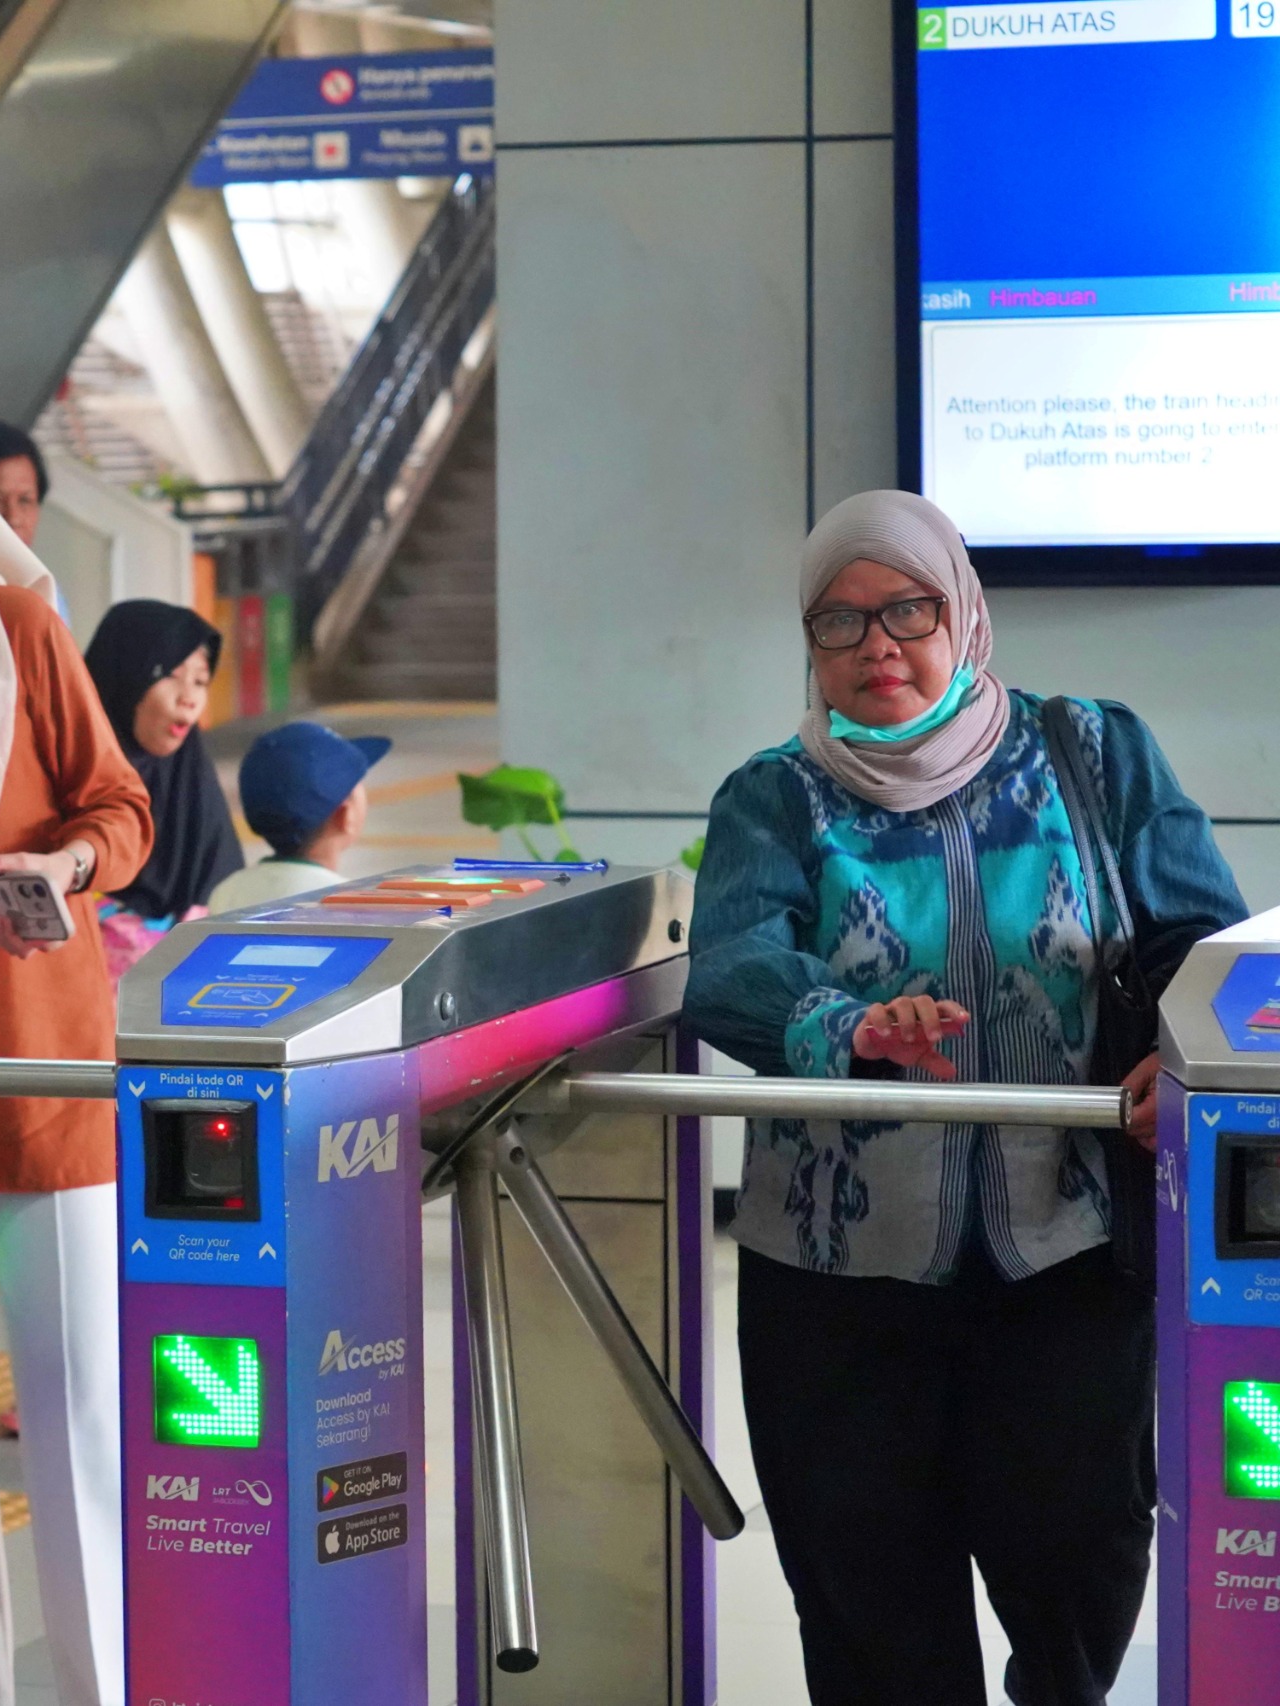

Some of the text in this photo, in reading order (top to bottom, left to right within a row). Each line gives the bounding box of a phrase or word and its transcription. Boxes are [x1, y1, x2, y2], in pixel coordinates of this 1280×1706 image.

[1240, 1, 1275, 28] 19
[923, 11, 1116, 43] 2 DUKUH ATAS
[989, 288, 1097, 307] Himbauan
[947, 396, 1037, 414] Attention
[1044, 394, 1118, 416] please,
[1124, 393, 1157, 411] the
[1163, 393, 1208, 410] train
[964, 424, 984, 441] to
[991, 421, 1056, 440] Dukuh
[1063, 421, 1107, 439] Atas
[1115, 424, 1131, 438] is
[1138, 423, 1195, 442] going
[1202, 421, 1221, 436] to
[1025, 446, 1213, 471] platform number 2
[160, 1073, 244, 1086] Pindai kode QR
[187, 1087, 219, 1098] di sini
[1237, 1101, 1276, 1114] Pindai
[318, 1114, 399, 1183] KAI
[178, 1234, 231, 1252] Scan your
[169, 1248, 240, 1261] QR code here
[1244, 1288, 1263, 1301] QR
[318, 1329, 406, 1376] Access
[378, 1363, 404, 1380] by KAI
[316, 1388, 372, 1413] Download
[317, 1403, 390, 1430] Access by KAI
[317, 1424, 371, 1448] Sekarang!
[344, 1469, 355, 1478] GET
[344, 1472, 402, 1496] Google Play
[146, 1475, 231, 1501] KAI LRT
[146, 1515, 271, 1536] Smart Travel
[345, 1511, 400, 1531] Download on the
[147, 1535, 253, 1555] Live Better
[345, 1526, 400, 1553] App Store
[1216, 1528, 1277, 1557] KAI
[1216, 1593, 1258, 1611] Live
